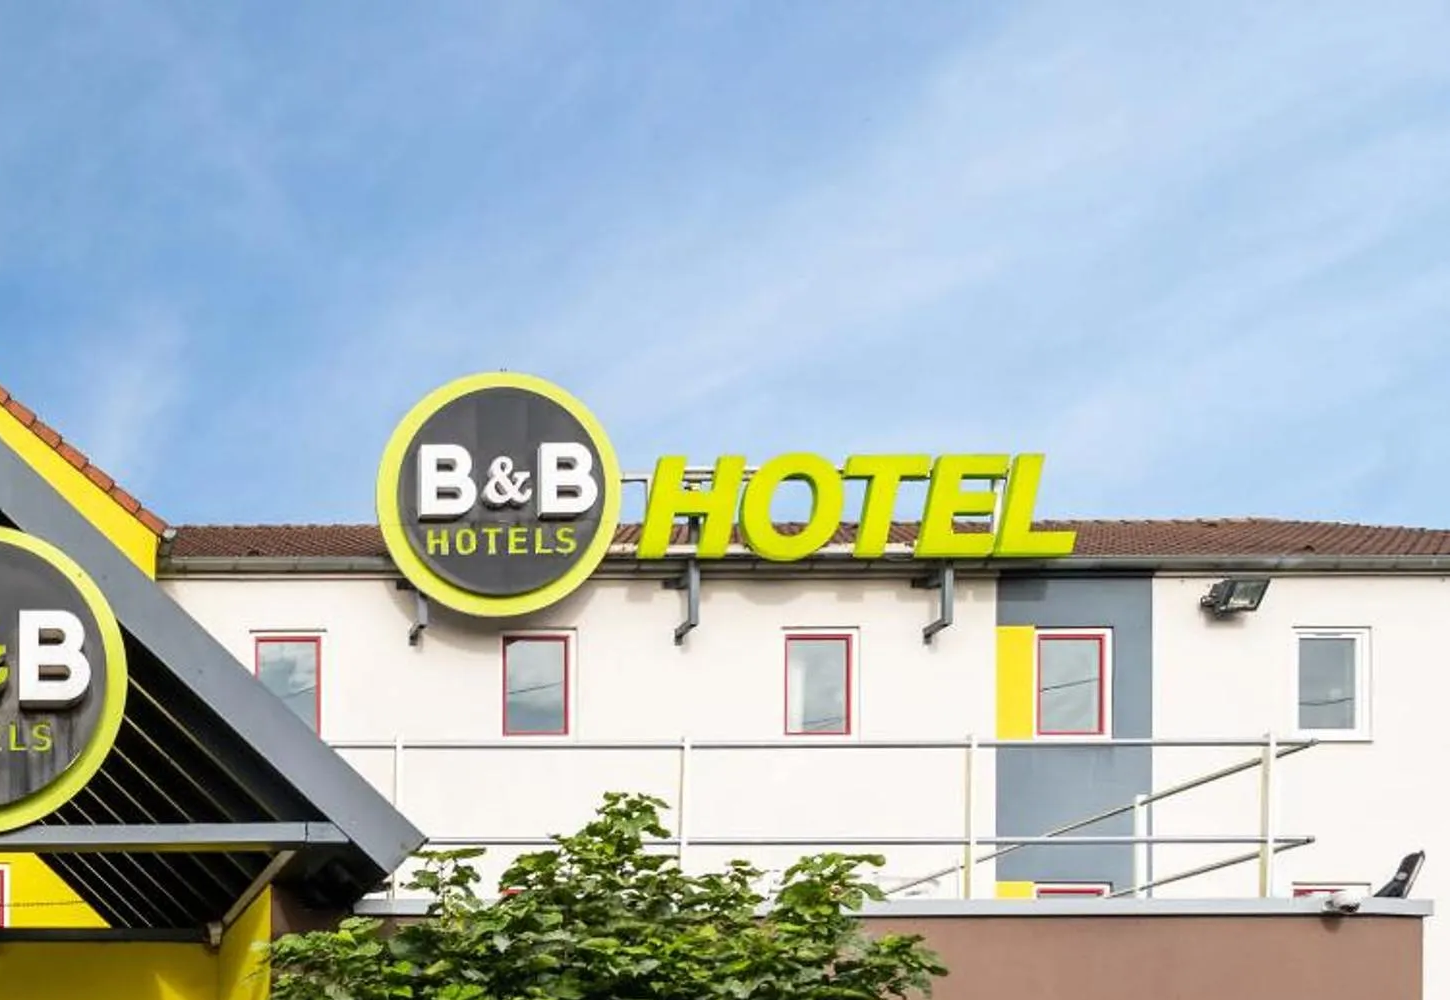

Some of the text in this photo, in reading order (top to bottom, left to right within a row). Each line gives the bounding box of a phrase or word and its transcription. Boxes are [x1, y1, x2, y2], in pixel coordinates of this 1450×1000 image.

[418, 442, 598, 521] B&B
[636, 452, 1078, 561] HOTEL
[426, 527, 578, 556] HOTELS
